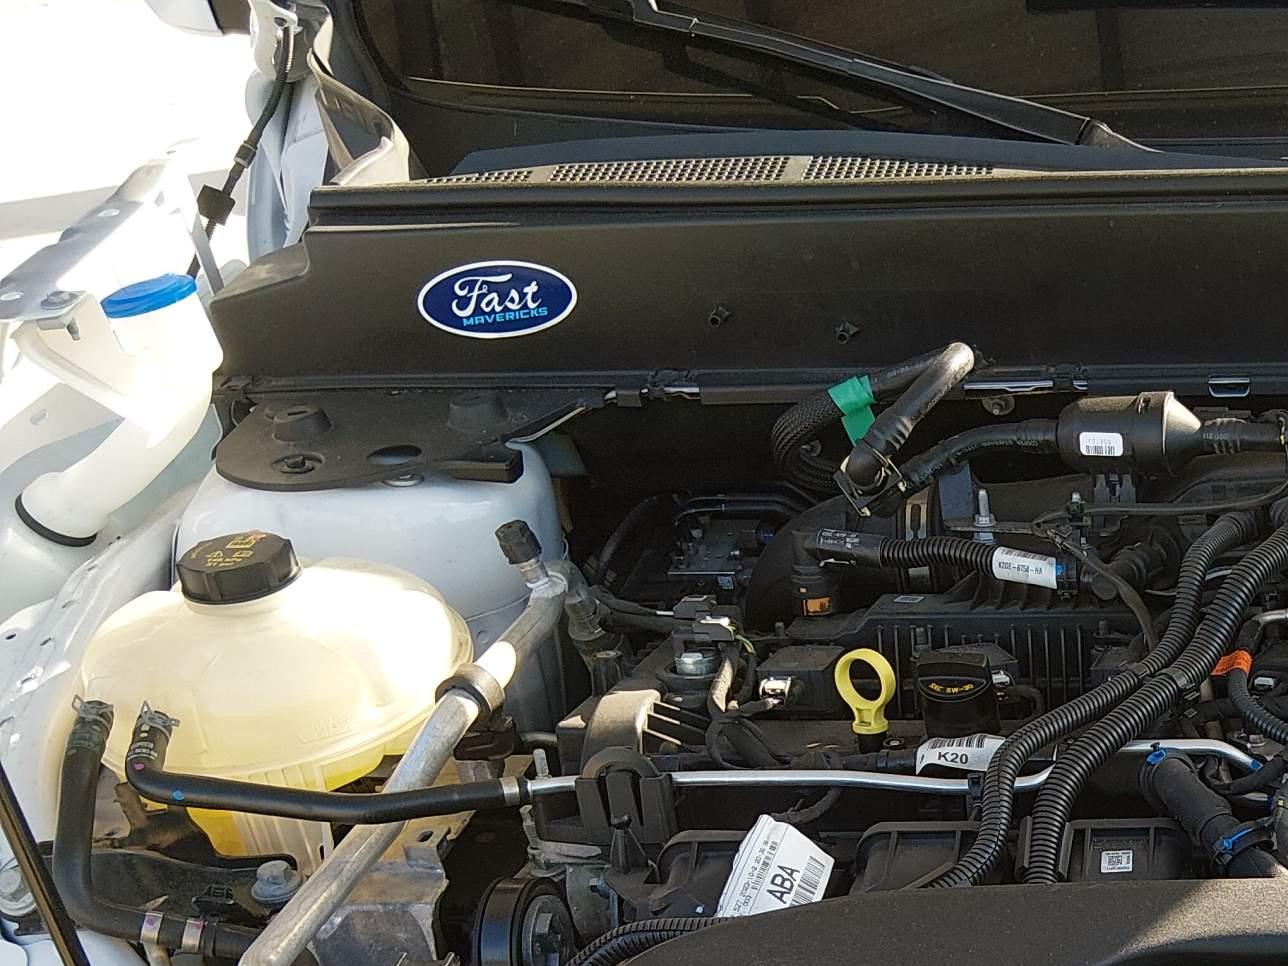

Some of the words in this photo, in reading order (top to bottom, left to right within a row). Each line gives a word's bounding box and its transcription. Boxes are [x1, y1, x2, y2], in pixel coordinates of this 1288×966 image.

[452, 273, 542, 317] Fast
[462, 307, 549, 327] MAVERICKS
[938, 751, 969, 765] K20
[766, 864, 801, 905] ABA
